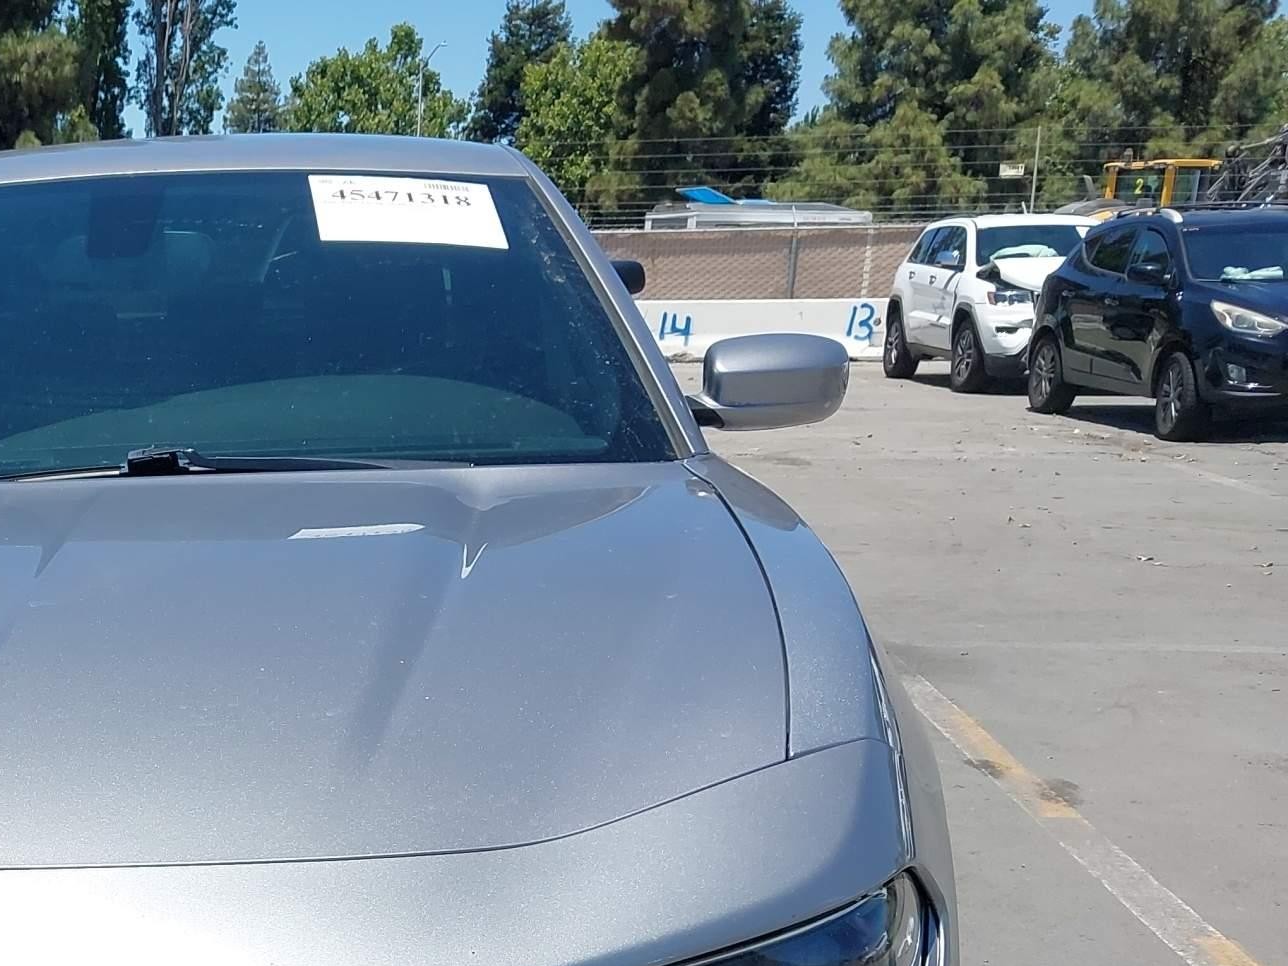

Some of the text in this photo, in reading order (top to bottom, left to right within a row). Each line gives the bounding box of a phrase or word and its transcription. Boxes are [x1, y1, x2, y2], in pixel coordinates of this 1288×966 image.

[331, 189, 472, 206] 45471318
[1135, 177, 1144, 195] 2
[659, 311, 692, 347] 14
[846, 302, 875, 341] 13
